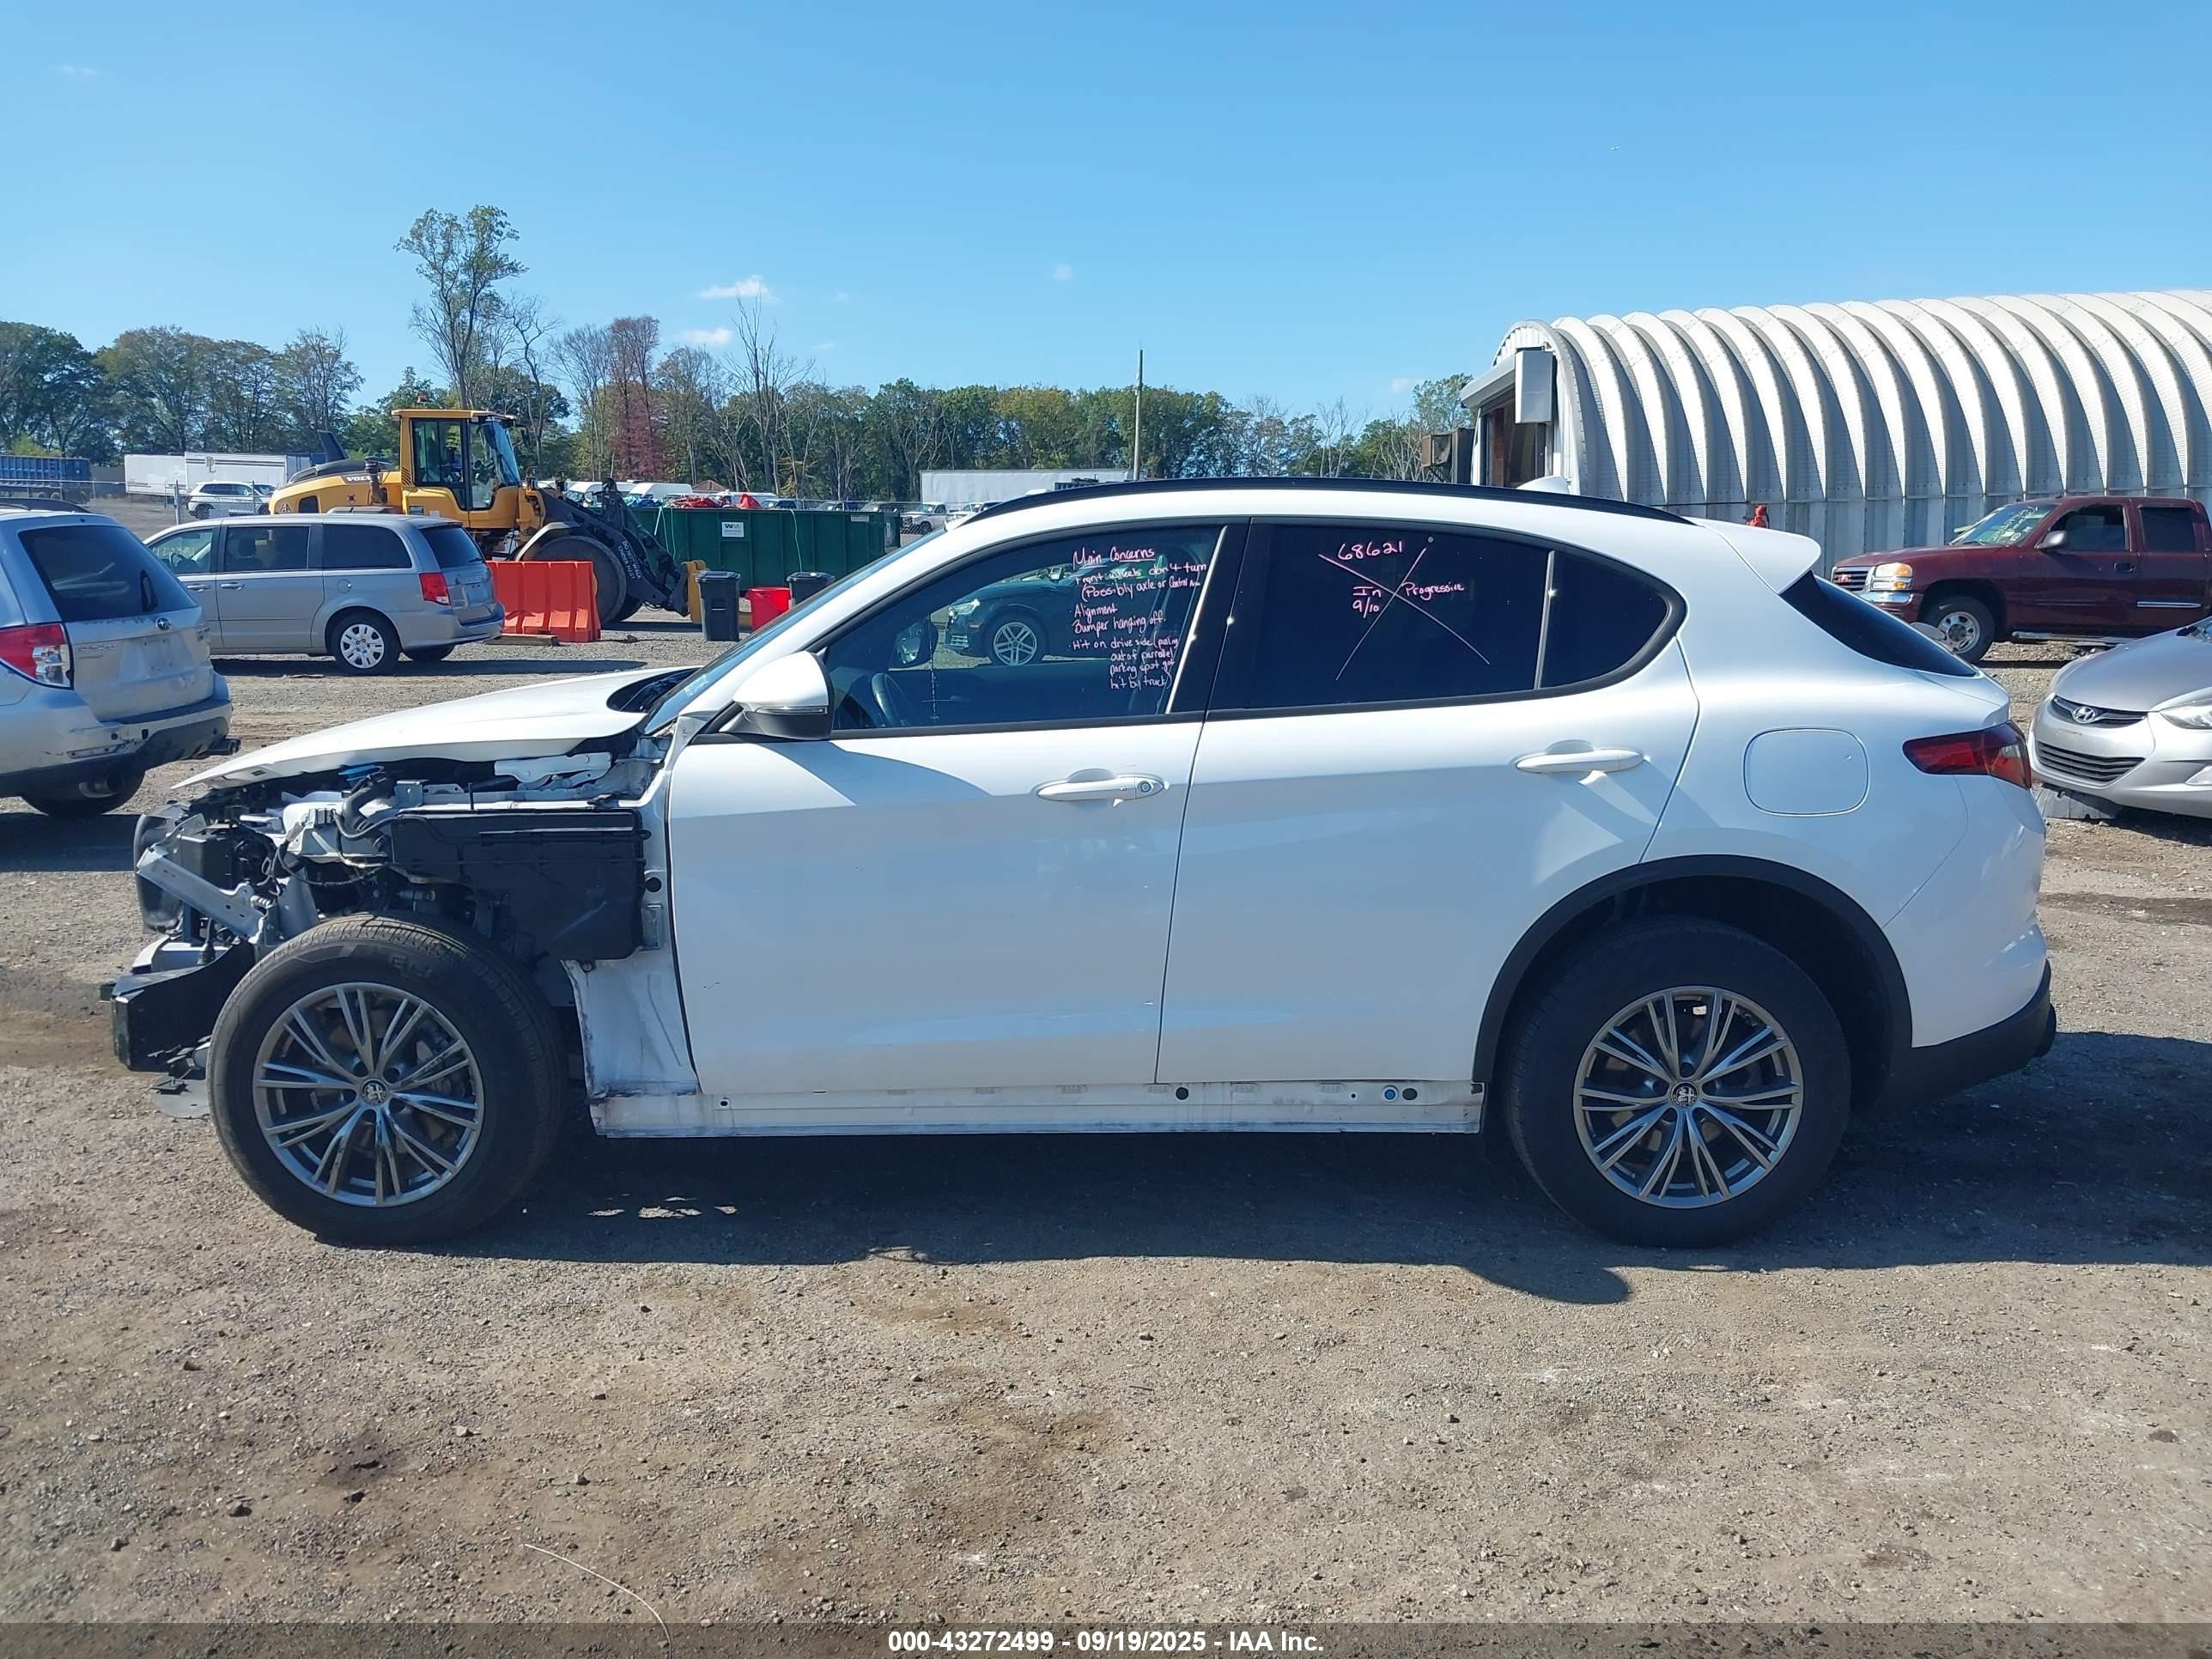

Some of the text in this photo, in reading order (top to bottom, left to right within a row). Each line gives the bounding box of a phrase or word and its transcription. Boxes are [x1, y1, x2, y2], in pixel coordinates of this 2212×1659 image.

[1073, 546, 1155, 570] Main Concerns
[1337, 541, 1402, 560] 68621
[1136, 579, 1156, 592] axle
[1158, 580, 1166, 588] or
[1401, 581, 1465, 600] Progressive
[1352, 597, 1380, 618] 9/10
[1072, 621, 1108, 637] Bumper
[1113, 616, 1146, 634] hanging
[1073, 638, 1091, 650] Hit
[1110, 649, 1126, 661] out
[1127, 649, 1138, 660] of
[1109, 661, 1138, 679] parking
[1110, 676, 1127, 690] hit
